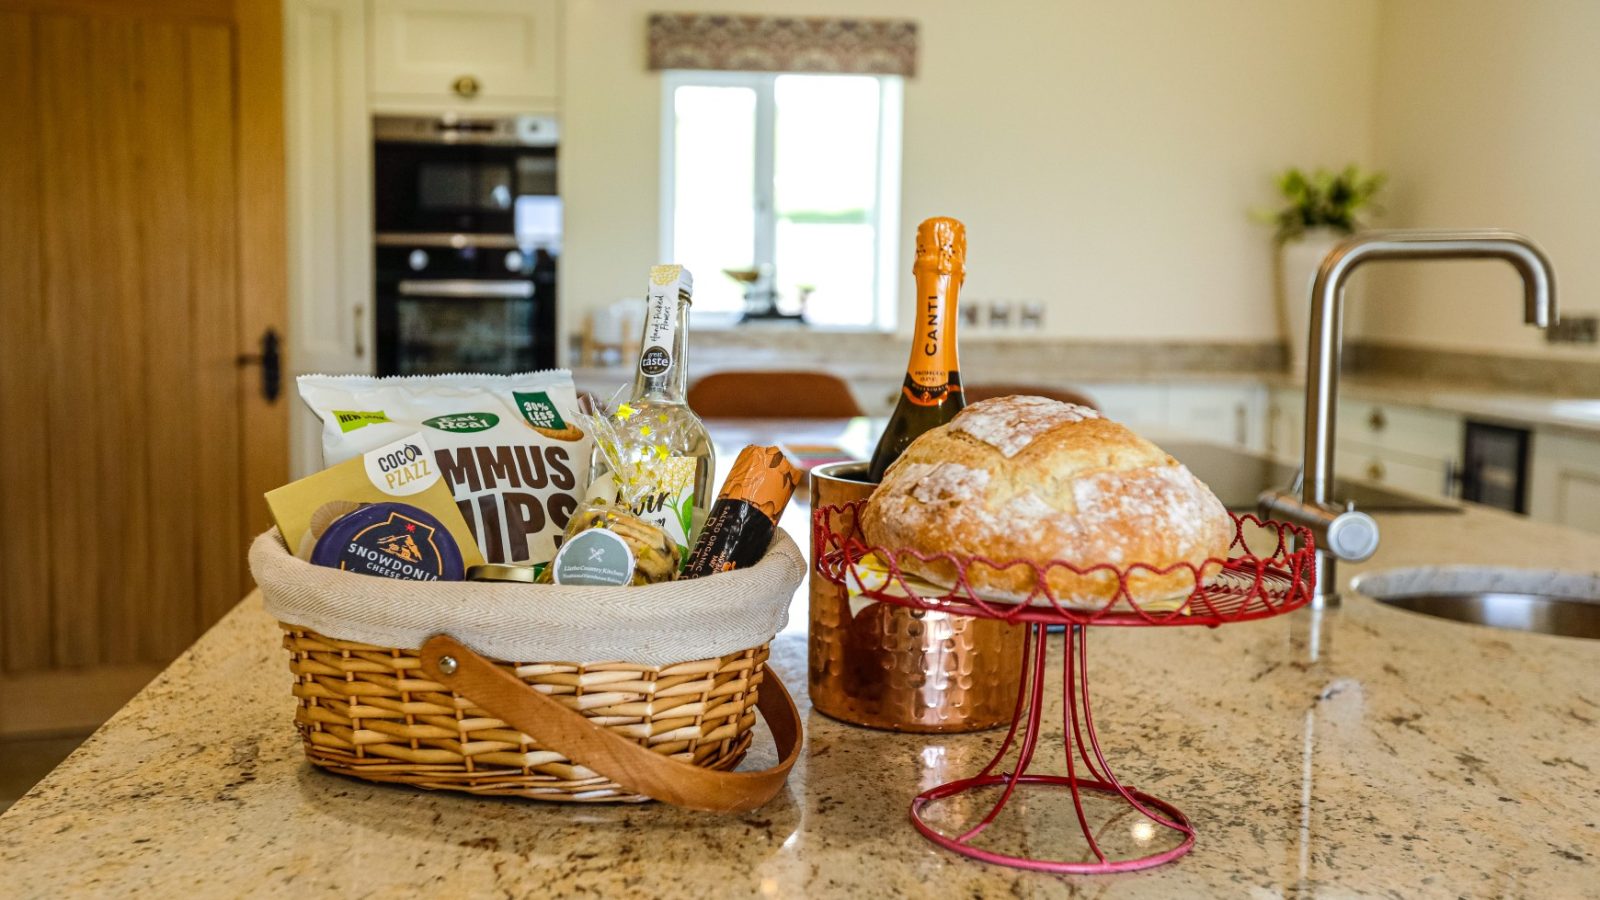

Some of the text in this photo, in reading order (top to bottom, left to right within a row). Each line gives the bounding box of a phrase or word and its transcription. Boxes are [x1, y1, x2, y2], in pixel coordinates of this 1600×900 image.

[924, 295, 938, 357] CANTI
[642, 356, 669, 367] taste
[647, 352, 663, 360] great
[523, 401, 549, 412] 30%
[339, 414, 361, 423] NEW
[439, 415, 478, 423] Eat
[527, 410, 555, 421] LESS
[436, 419, 491, 430] Real
[377, 445, 417, 473] COCO
[385, 459, 432, 490] PZAZZ
[713, 505, 731, 533] SALTED
[695, 535, 717, 572] ORGANIC
[347, 543, 438, 582] SNOWDONIA
[366, 562, 401, 579] CHEESE
